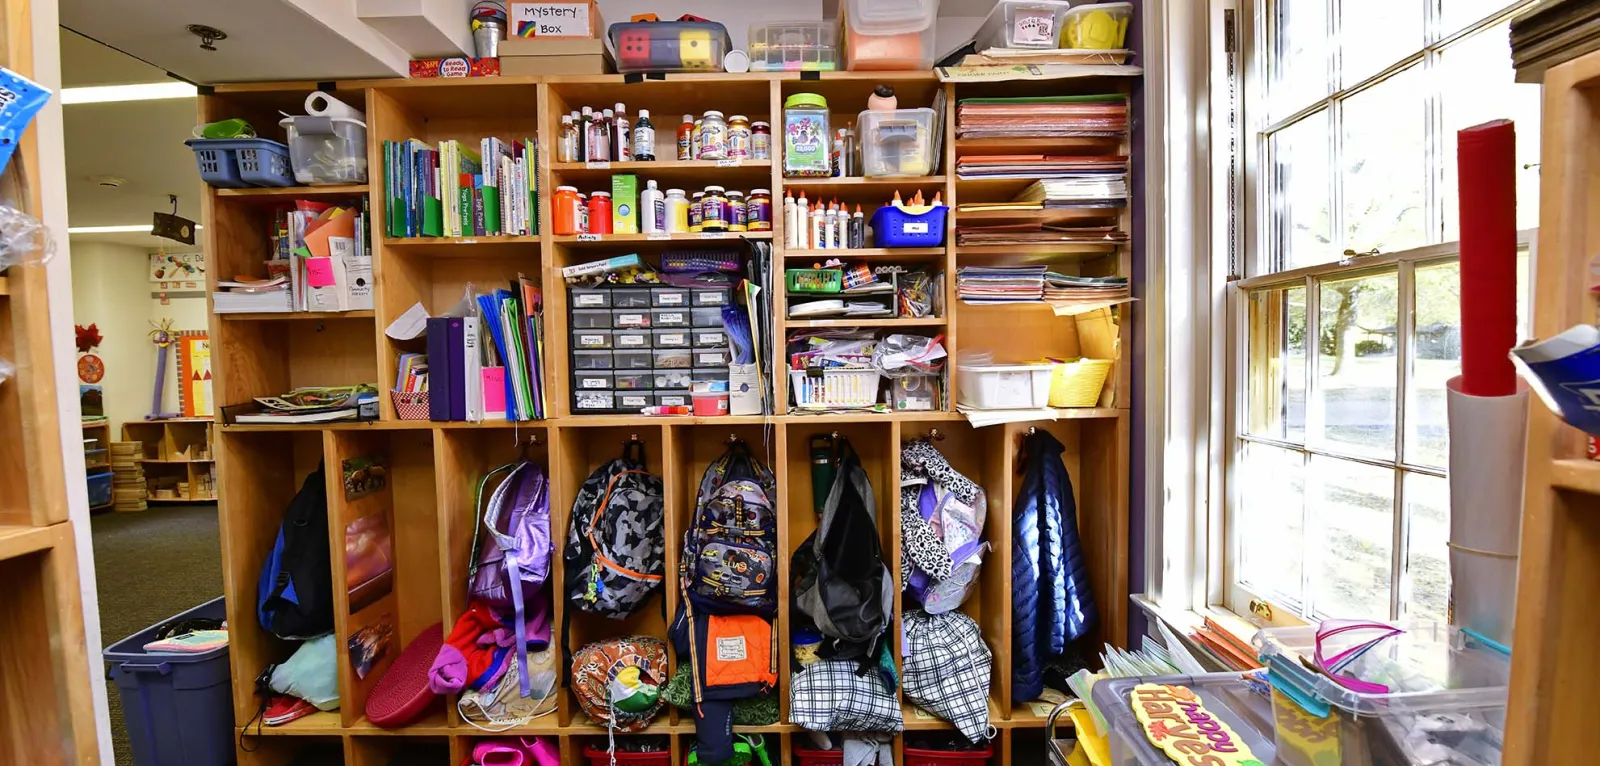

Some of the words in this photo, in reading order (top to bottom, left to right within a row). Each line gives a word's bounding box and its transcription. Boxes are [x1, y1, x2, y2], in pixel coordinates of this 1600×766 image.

[524, 6, 577, 19] Mystery
[540, 24, 562, 34] Box
[475, 198, 484, 211] Yoga
